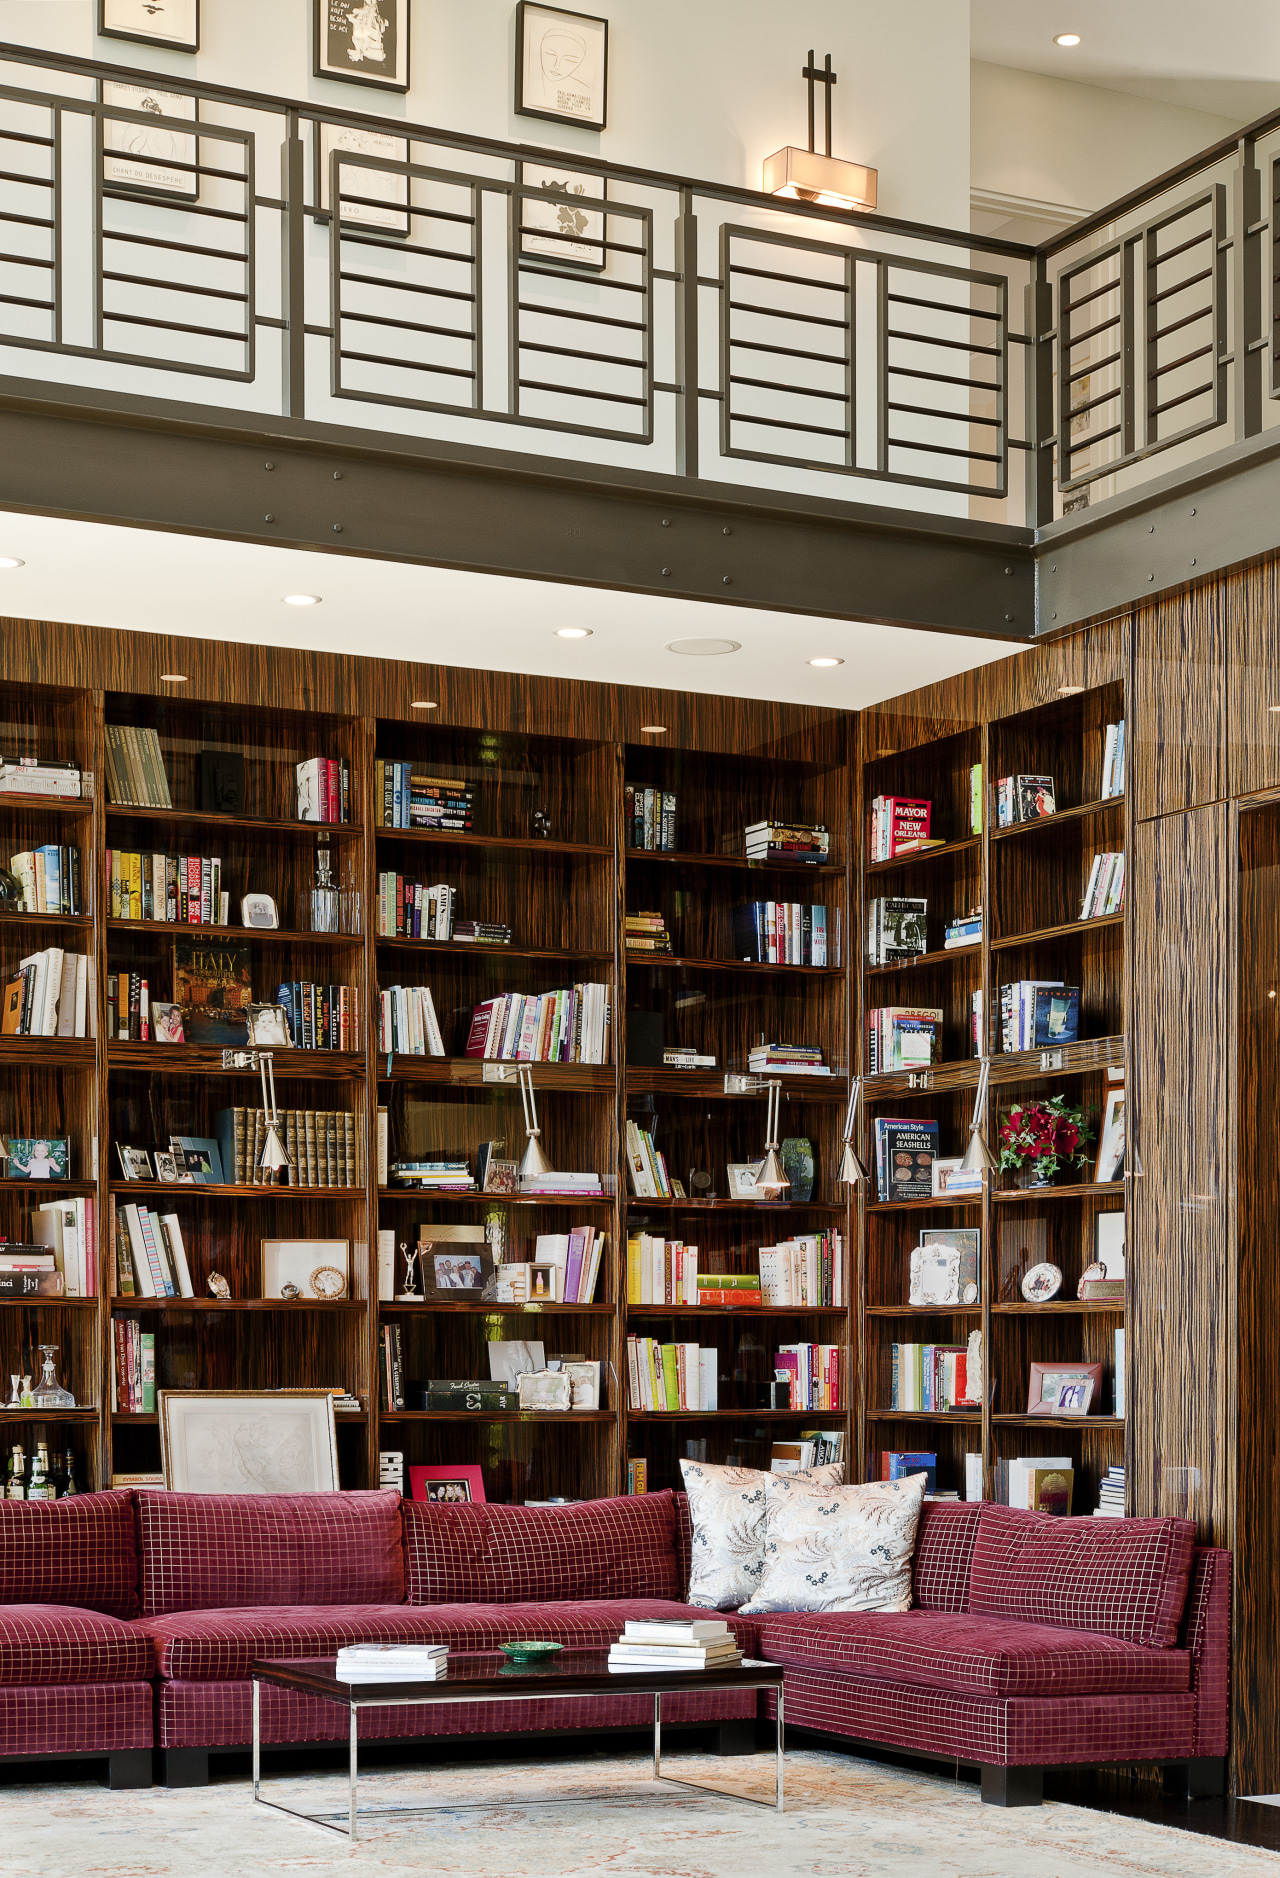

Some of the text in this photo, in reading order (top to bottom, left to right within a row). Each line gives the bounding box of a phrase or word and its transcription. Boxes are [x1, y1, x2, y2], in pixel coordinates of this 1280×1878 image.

[373, 140, 393, 148] VERCORS
[113, 167, 132, 175] CHANT
[385, 781, 393, 790] THE
[319, 769, 328, 816] Christian Dior
[457, 801, 467, 809] LONG
[894, 807, 928, 818] MAYOR
[668, 813, 676, 848] LINDBERGH
[899, 821, 922, 831] NEW
[894, 829, 927, 838] ORLEANS
[155, 893, 165, 910] 1865
[192, 952, 237, 971] ITALY
[315, 1029, 324, 1045] Dragon
[883, 1122, 924, 1131] American Style
[895, 1132, 931, 1141] AMERICAN
[895, 1140, 931, 1149] SEASHELLS
[630, 1359, 640, 1404] NUTRITIONAL HEALING
[665, 1361, 673, 1394] Vegetarian
[450, 1381, 463, 1390] Frank
[636, 1463, 644, 1481] FILM
